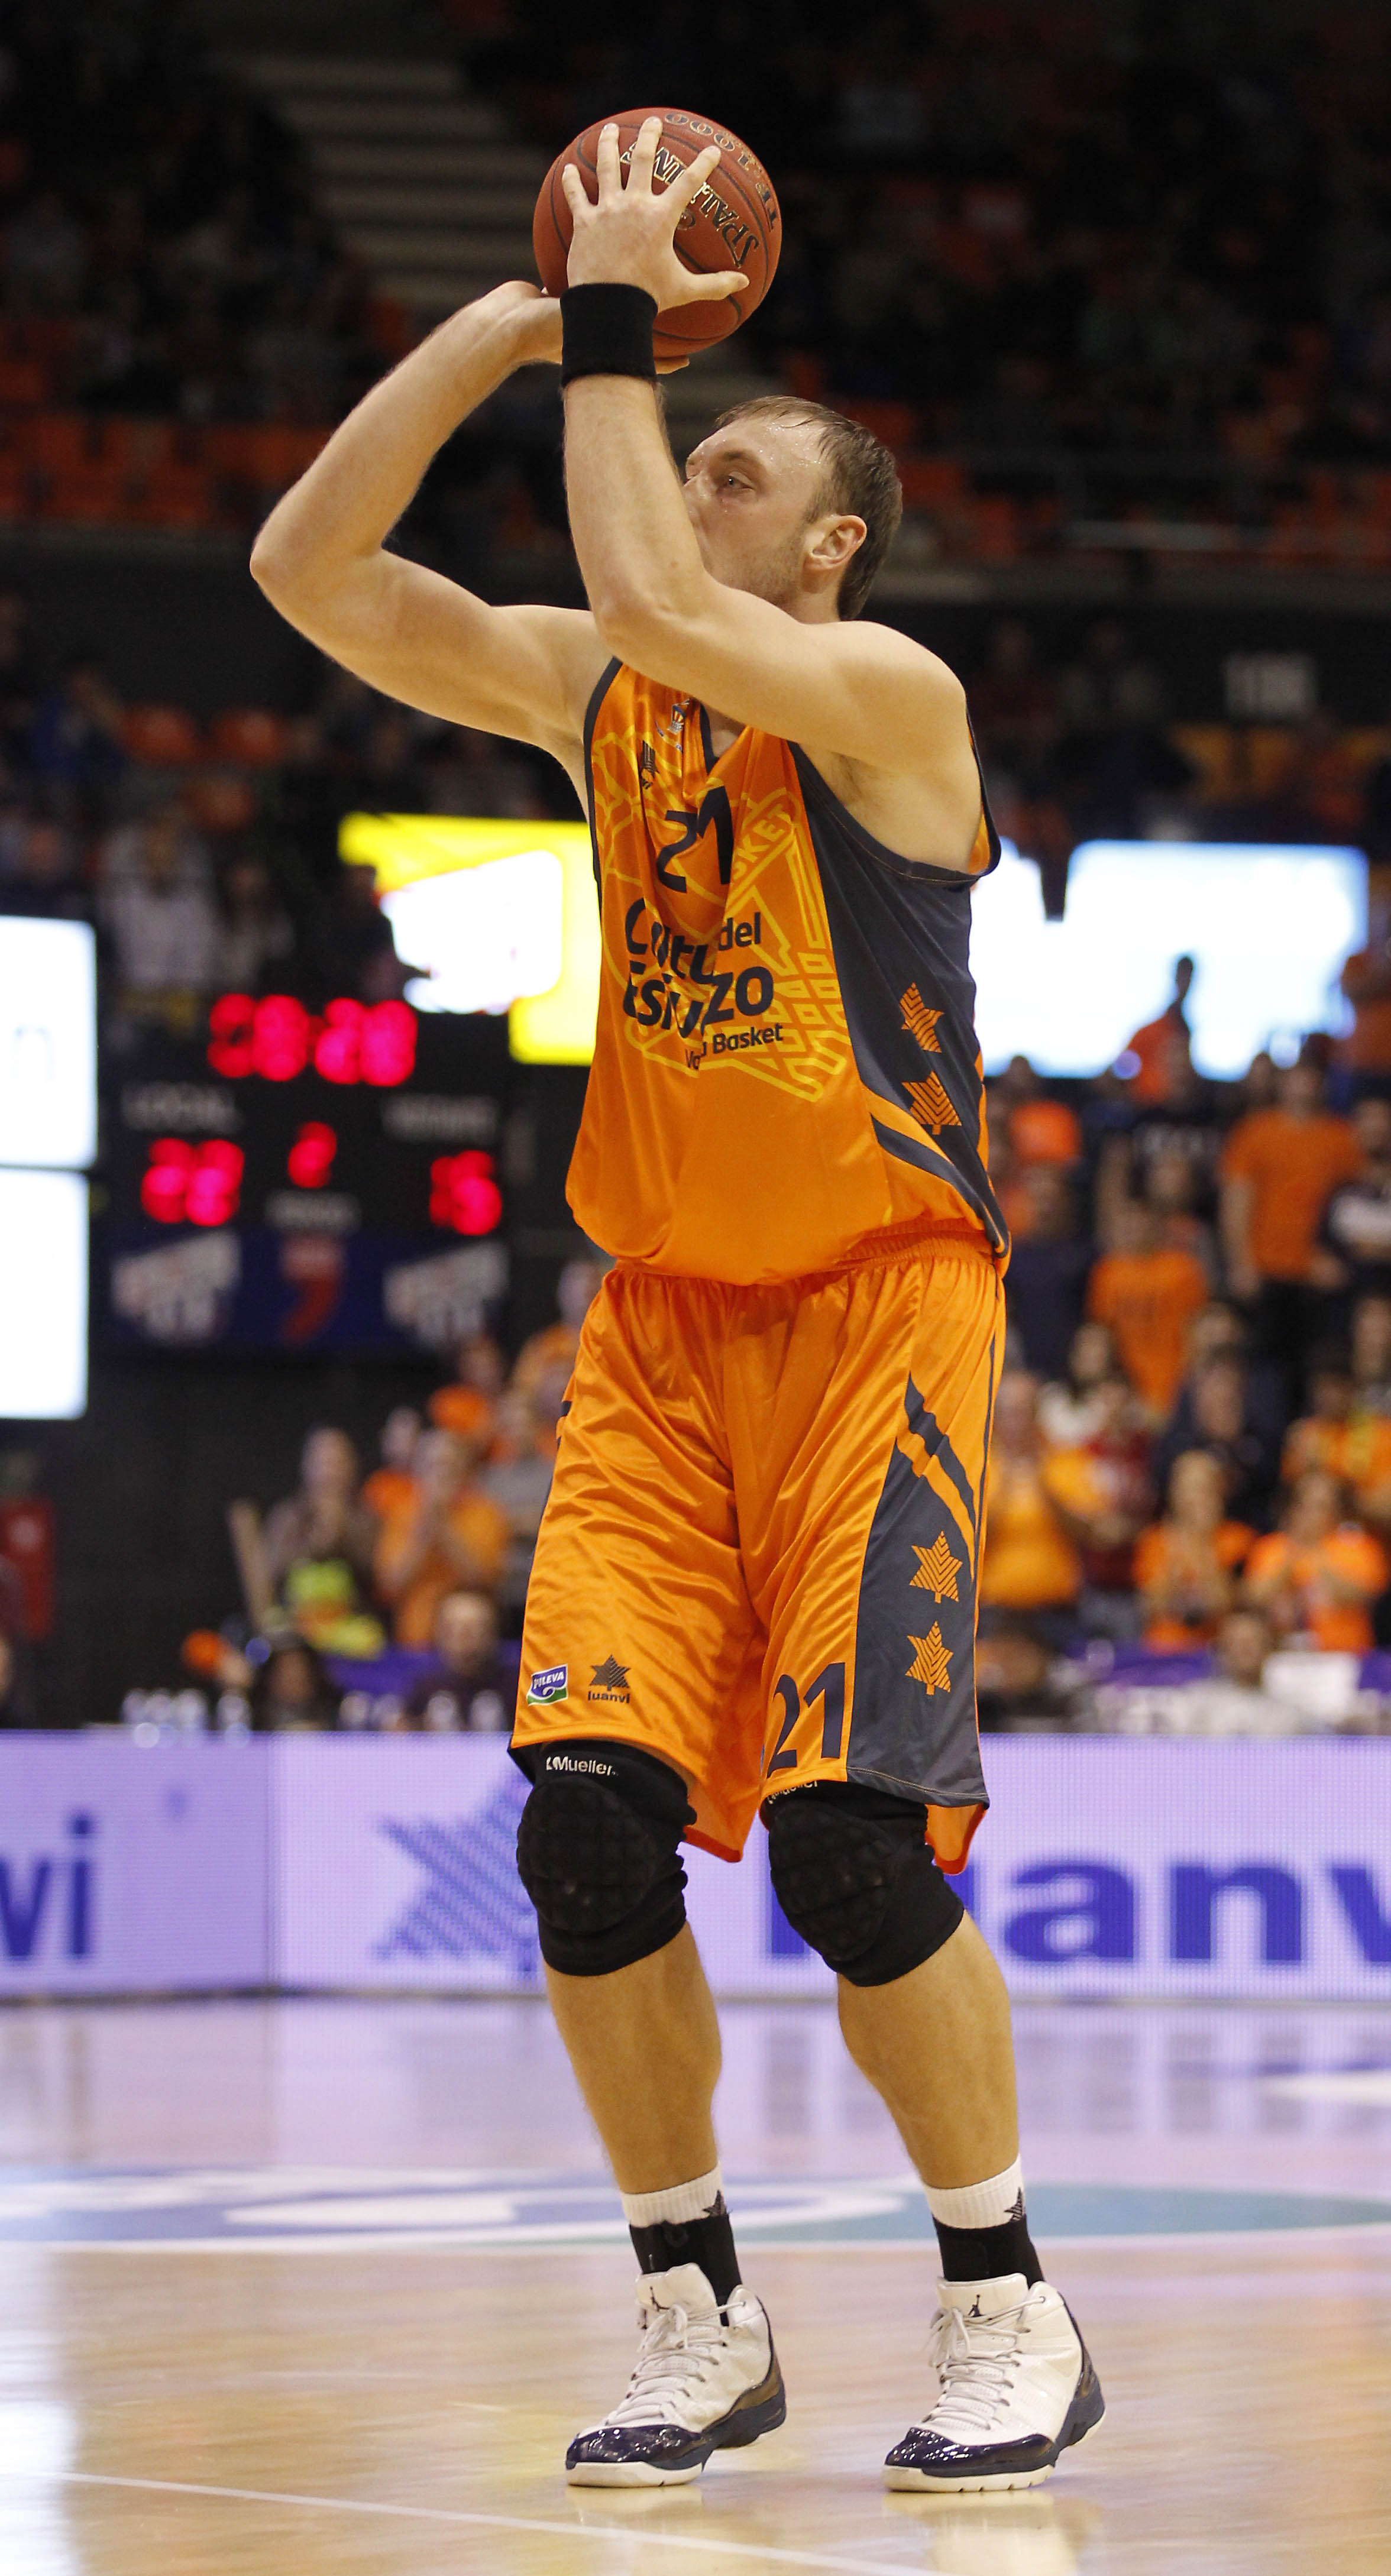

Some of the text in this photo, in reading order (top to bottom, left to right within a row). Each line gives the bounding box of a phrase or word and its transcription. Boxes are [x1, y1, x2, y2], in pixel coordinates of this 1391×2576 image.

[620, 141, 760, 268] SPALIN
[656, 785, 735, 893] 21
[717, 912, 761, 952] del
[713, 1023, 784, 1054] Basket
[587, 1690, 630, 1704] luanvi
[766, 1662, 846, 1779] 21
[552, 1755, 613, 1776] Mueller
